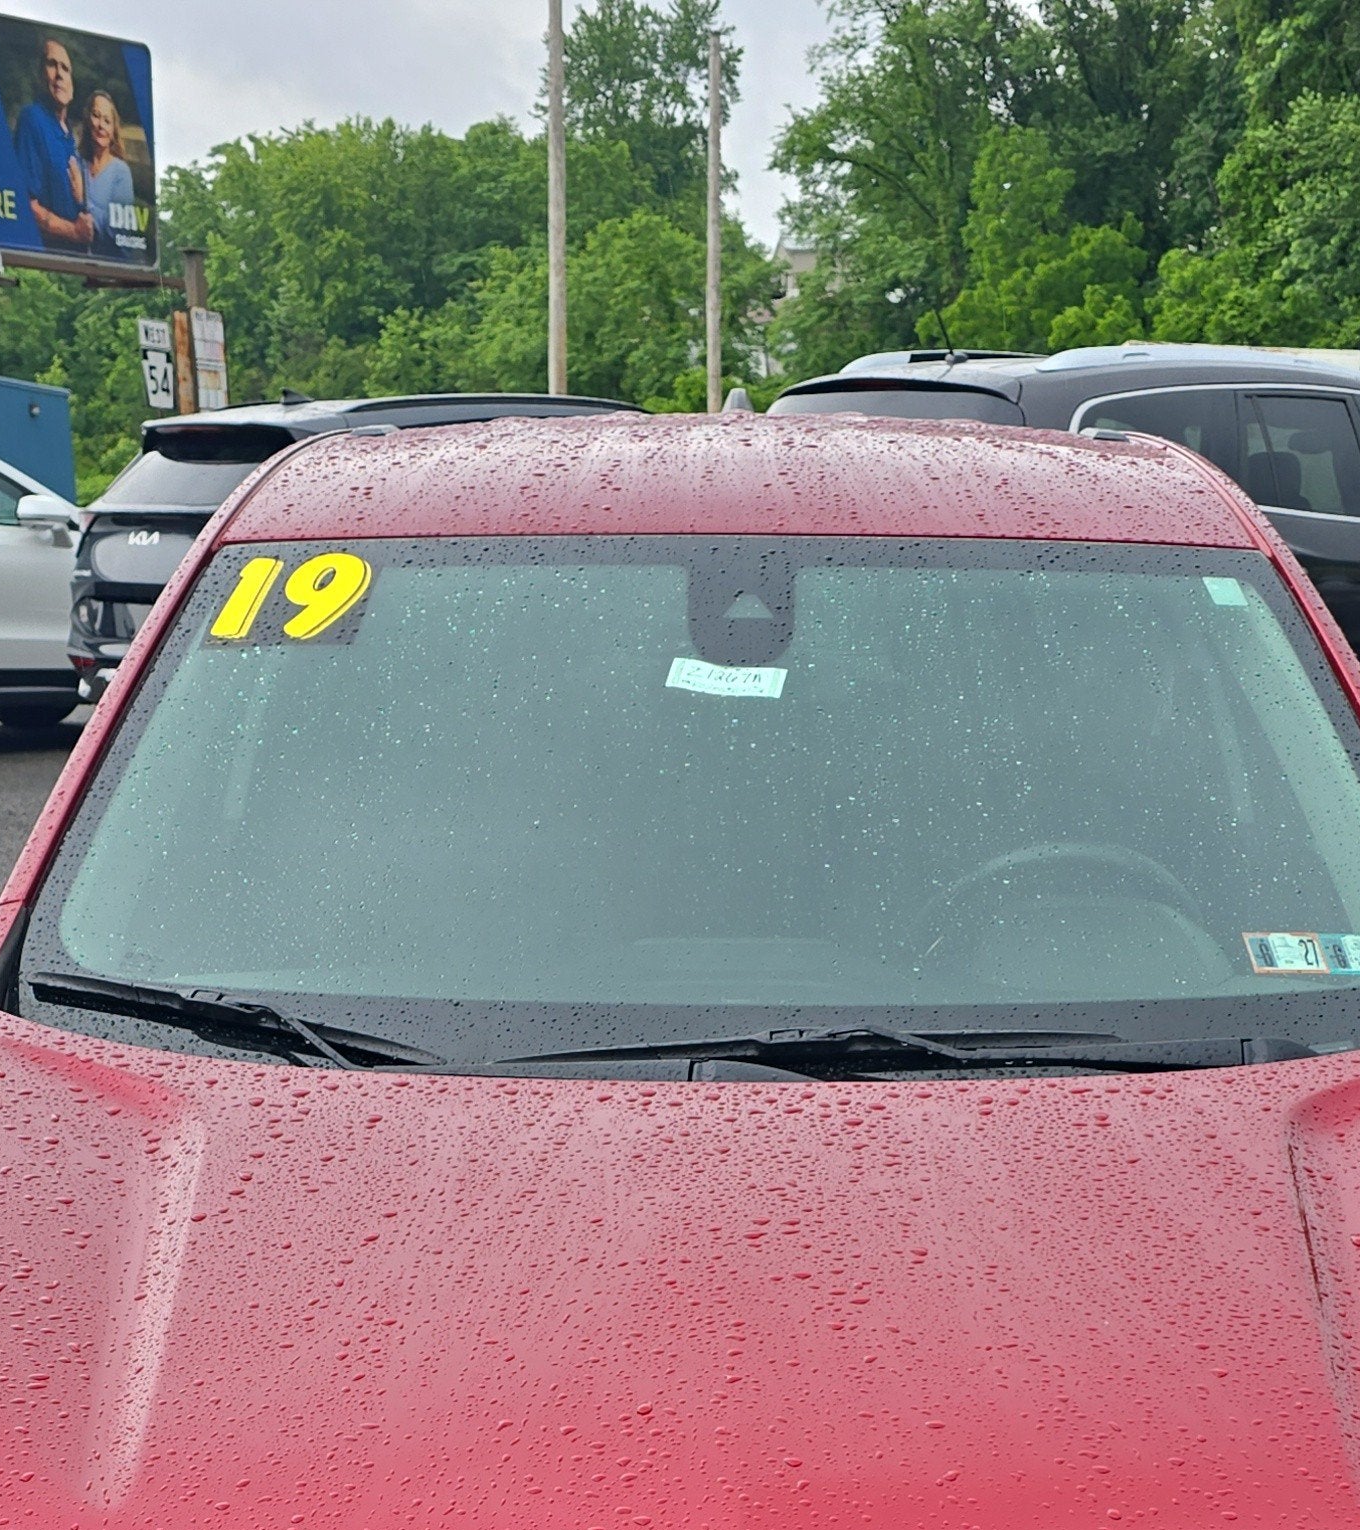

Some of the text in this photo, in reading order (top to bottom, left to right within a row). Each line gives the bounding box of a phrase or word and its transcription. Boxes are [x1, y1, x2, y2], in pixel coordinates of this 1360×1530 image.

[148, 364, 171, 395] 54
[210, 552, 372, 640] 19
[1297, 939, 1320, 968] 27
